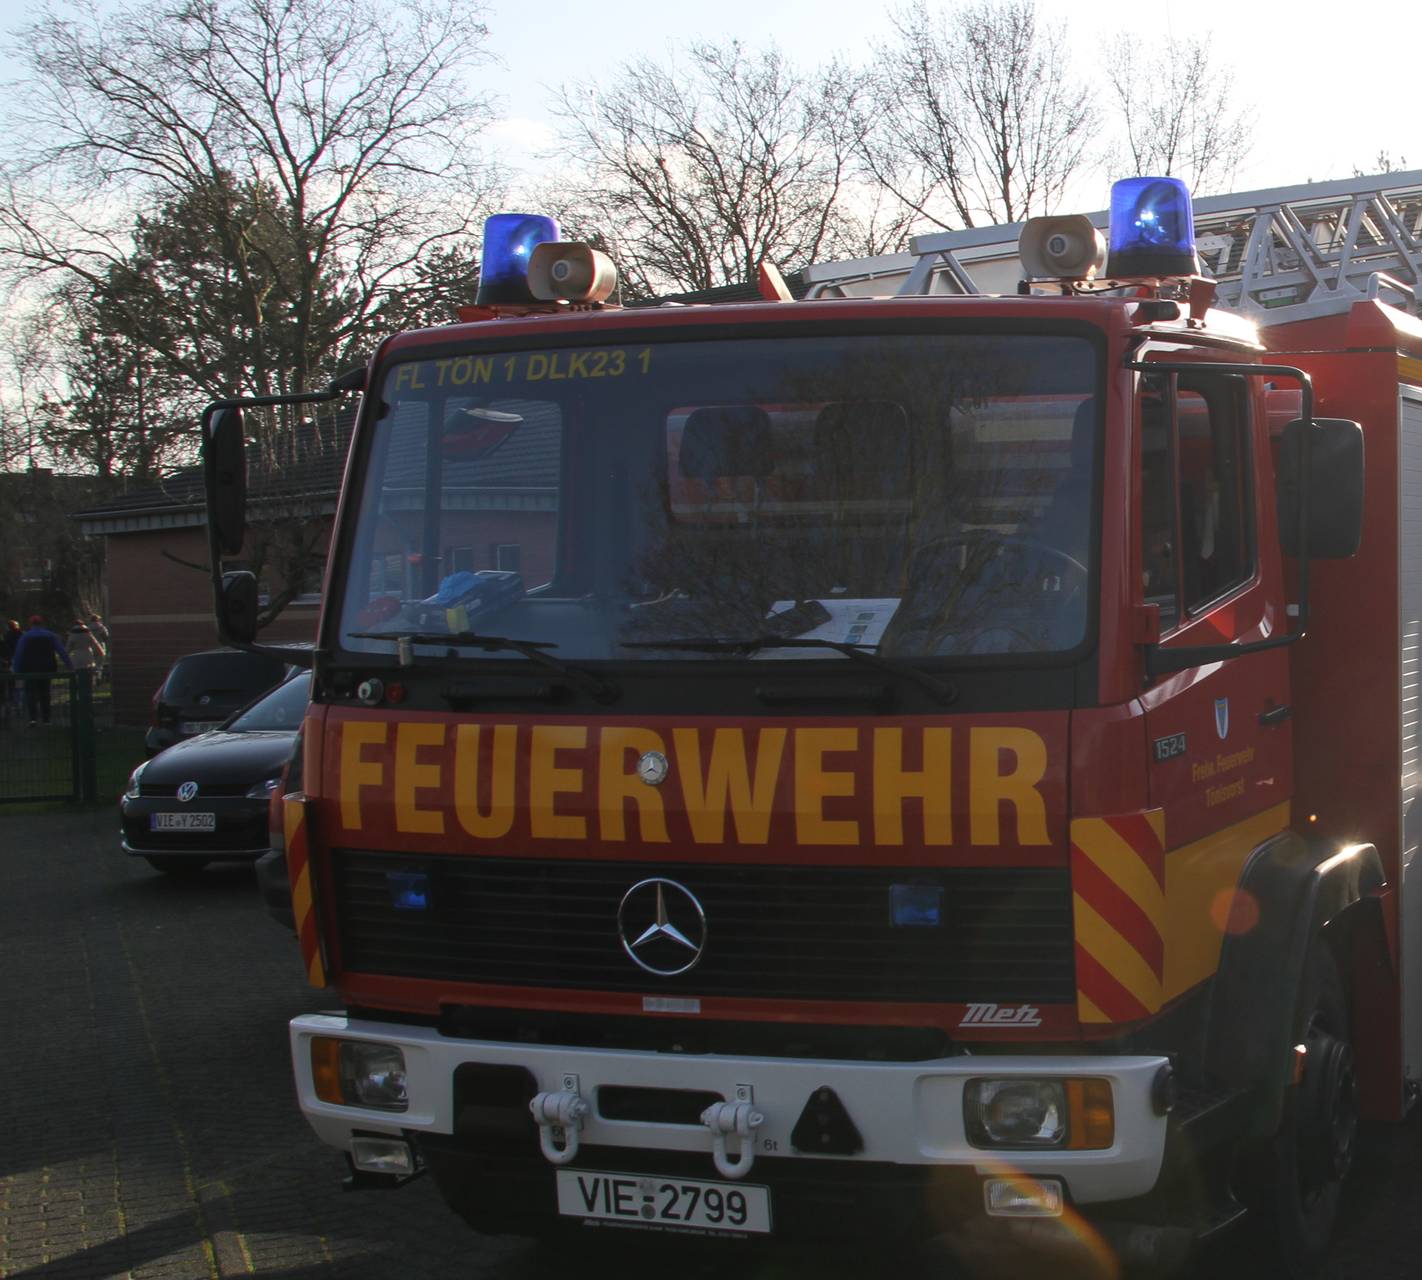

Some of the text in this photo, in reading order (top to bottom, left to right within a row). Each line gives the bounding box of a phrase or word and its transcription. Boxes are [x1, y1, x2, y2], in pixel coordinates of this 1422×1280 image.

[395, 365, 425, 391] FL
[504, 355, 518, 382] 1
[526, 350, 626, 381] DLK23
[638, 347, 652, 374] 1
[1156, 734, 1185, 759] 1524
[340, 721, 1053, 846] FEUERWEHR
[157, 815, 175, 828] VIE
[959, 1003, 1042, 1027] Metz
[763, 1139, 779, 1151] 6t
